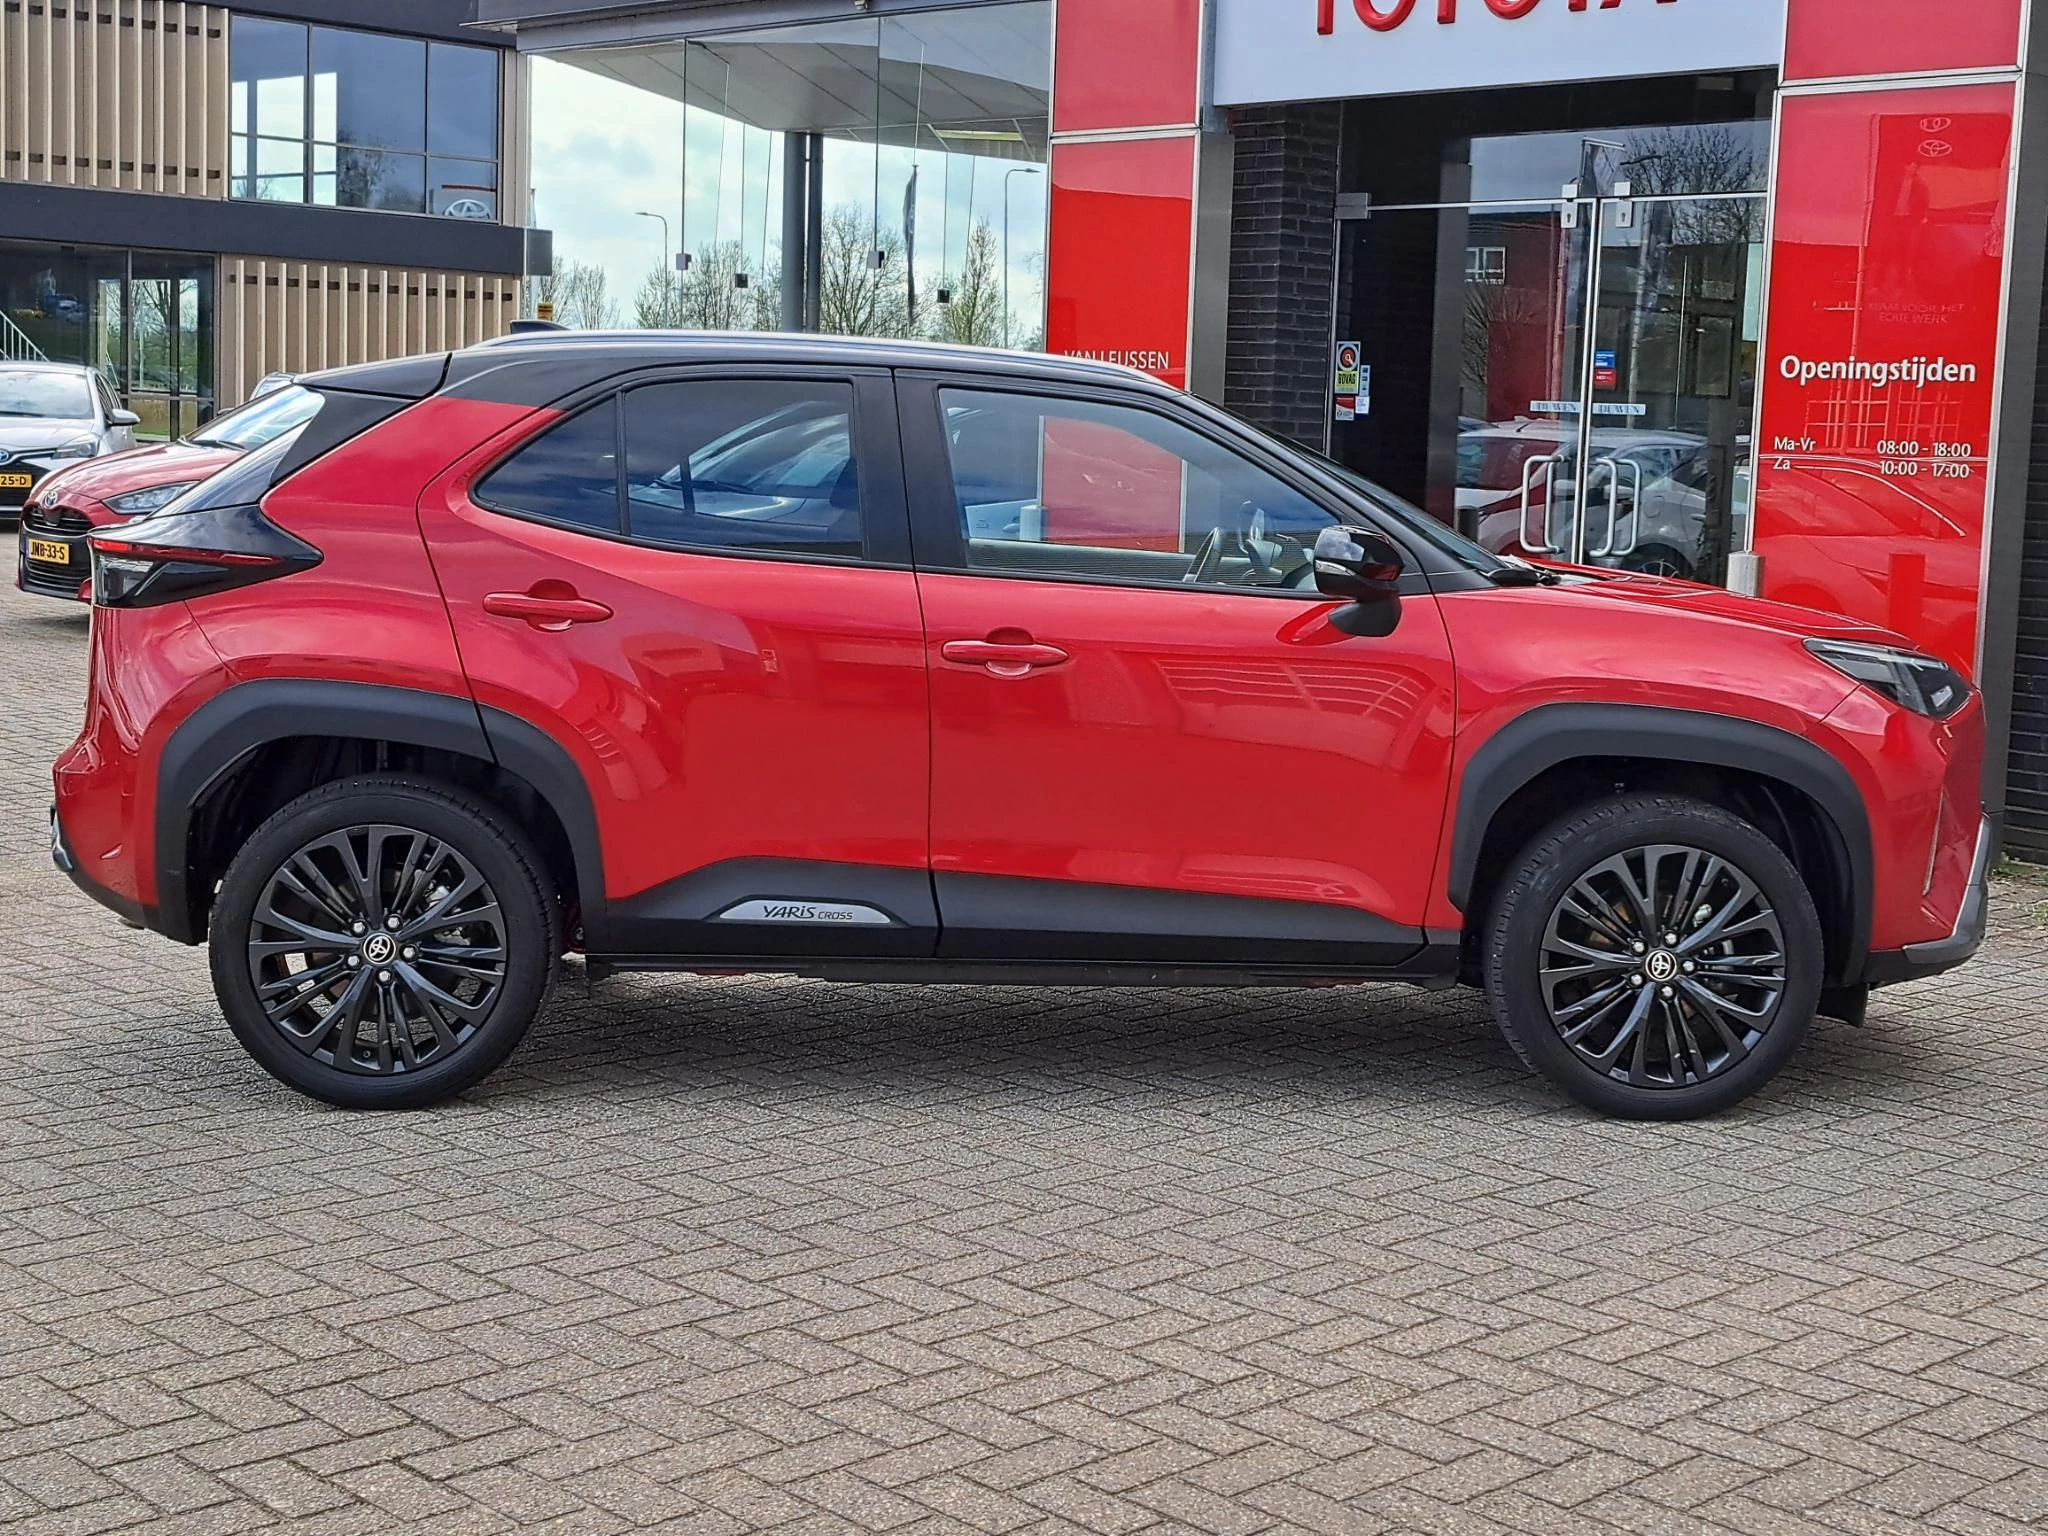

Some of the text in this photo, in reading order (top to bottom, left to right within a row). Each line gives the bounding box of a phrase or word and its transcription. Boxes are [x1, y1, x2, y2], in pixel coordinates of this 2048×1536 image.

[1780, 355, 1977, 389] Openingstijden
[1773, 436, 1817, 452] Ma-Vr
[1876, 440, 1918, 456] 08:00
[1932, 441, 1971, 458] 18:00
[1772, 457, 1791, 471] Za
[1880, 461, 1918, 476] 10:00
[1931, 463, 1970, 478] 17:00
[817, 911, 854, 920] CROSS
